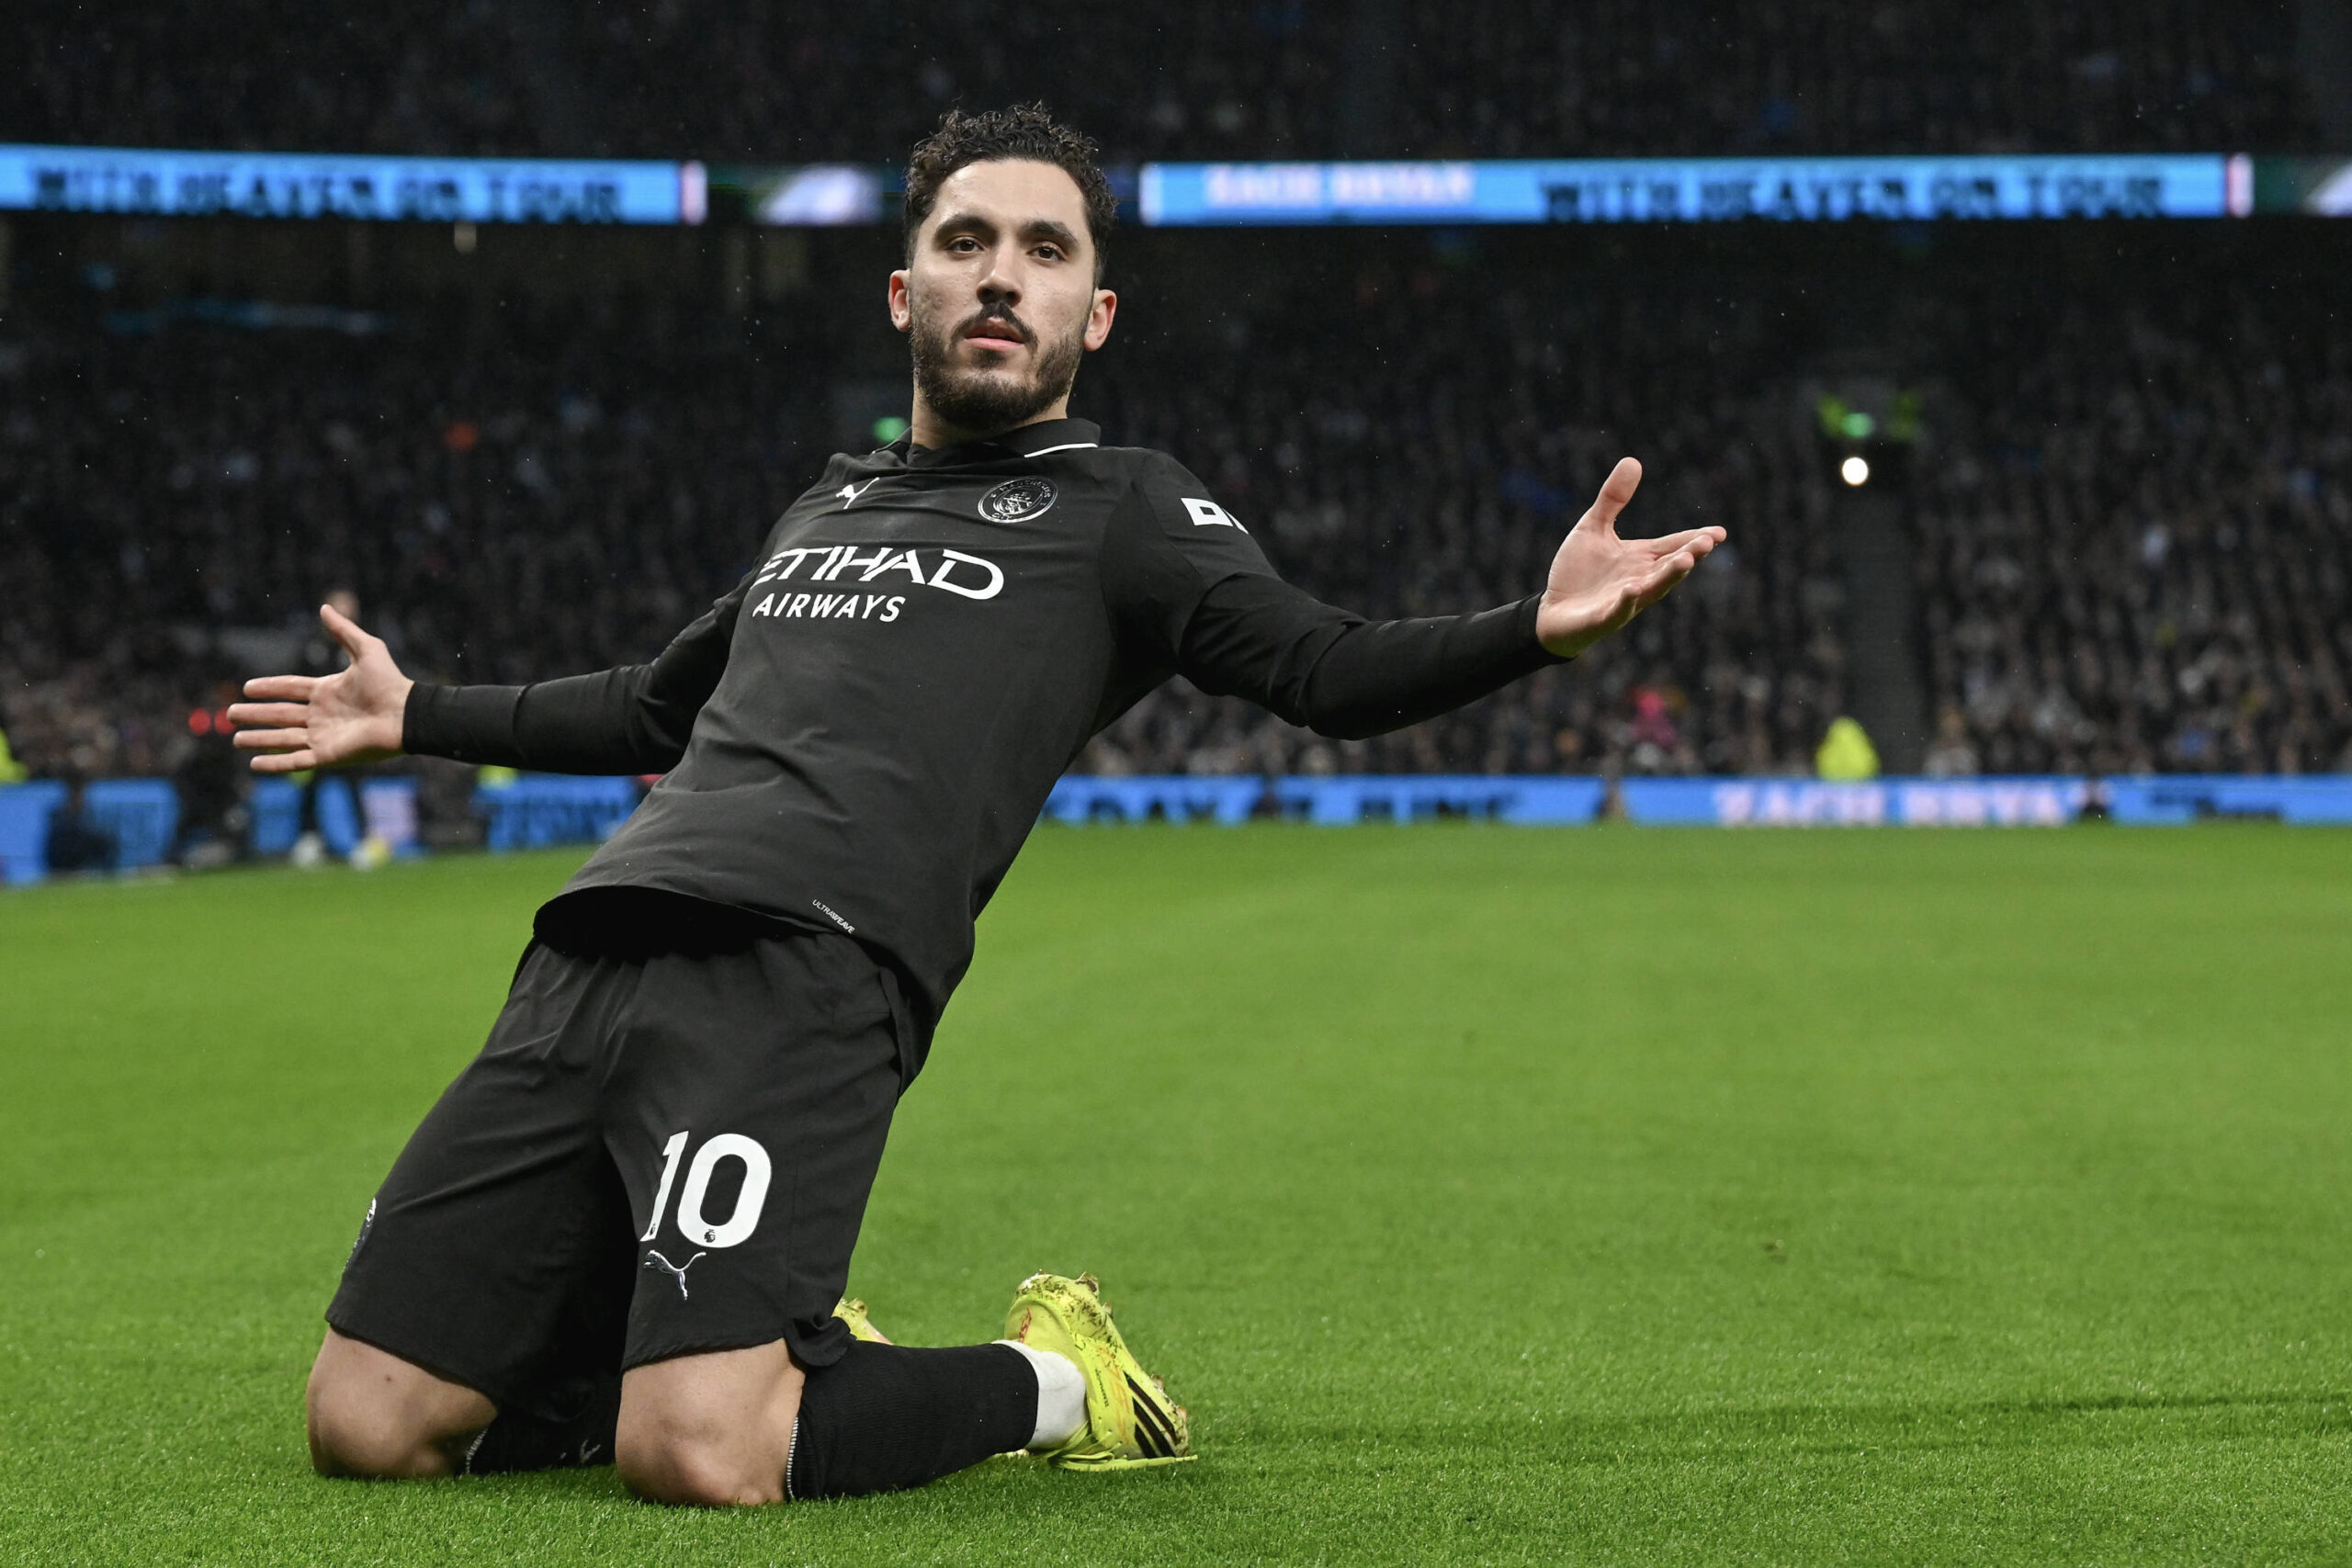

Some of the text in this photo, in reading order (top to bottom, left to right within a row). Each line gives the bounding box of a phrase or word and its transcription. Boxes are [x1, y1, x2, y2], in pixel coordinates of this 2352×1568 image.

[750, 546, 1004, 600] ETIHAD
[752, 592, 905, 622] AIRWAYS
[812, 899, 855, 934] ULTRAWEAVE
[640, 1131, 772, 1248] 10
